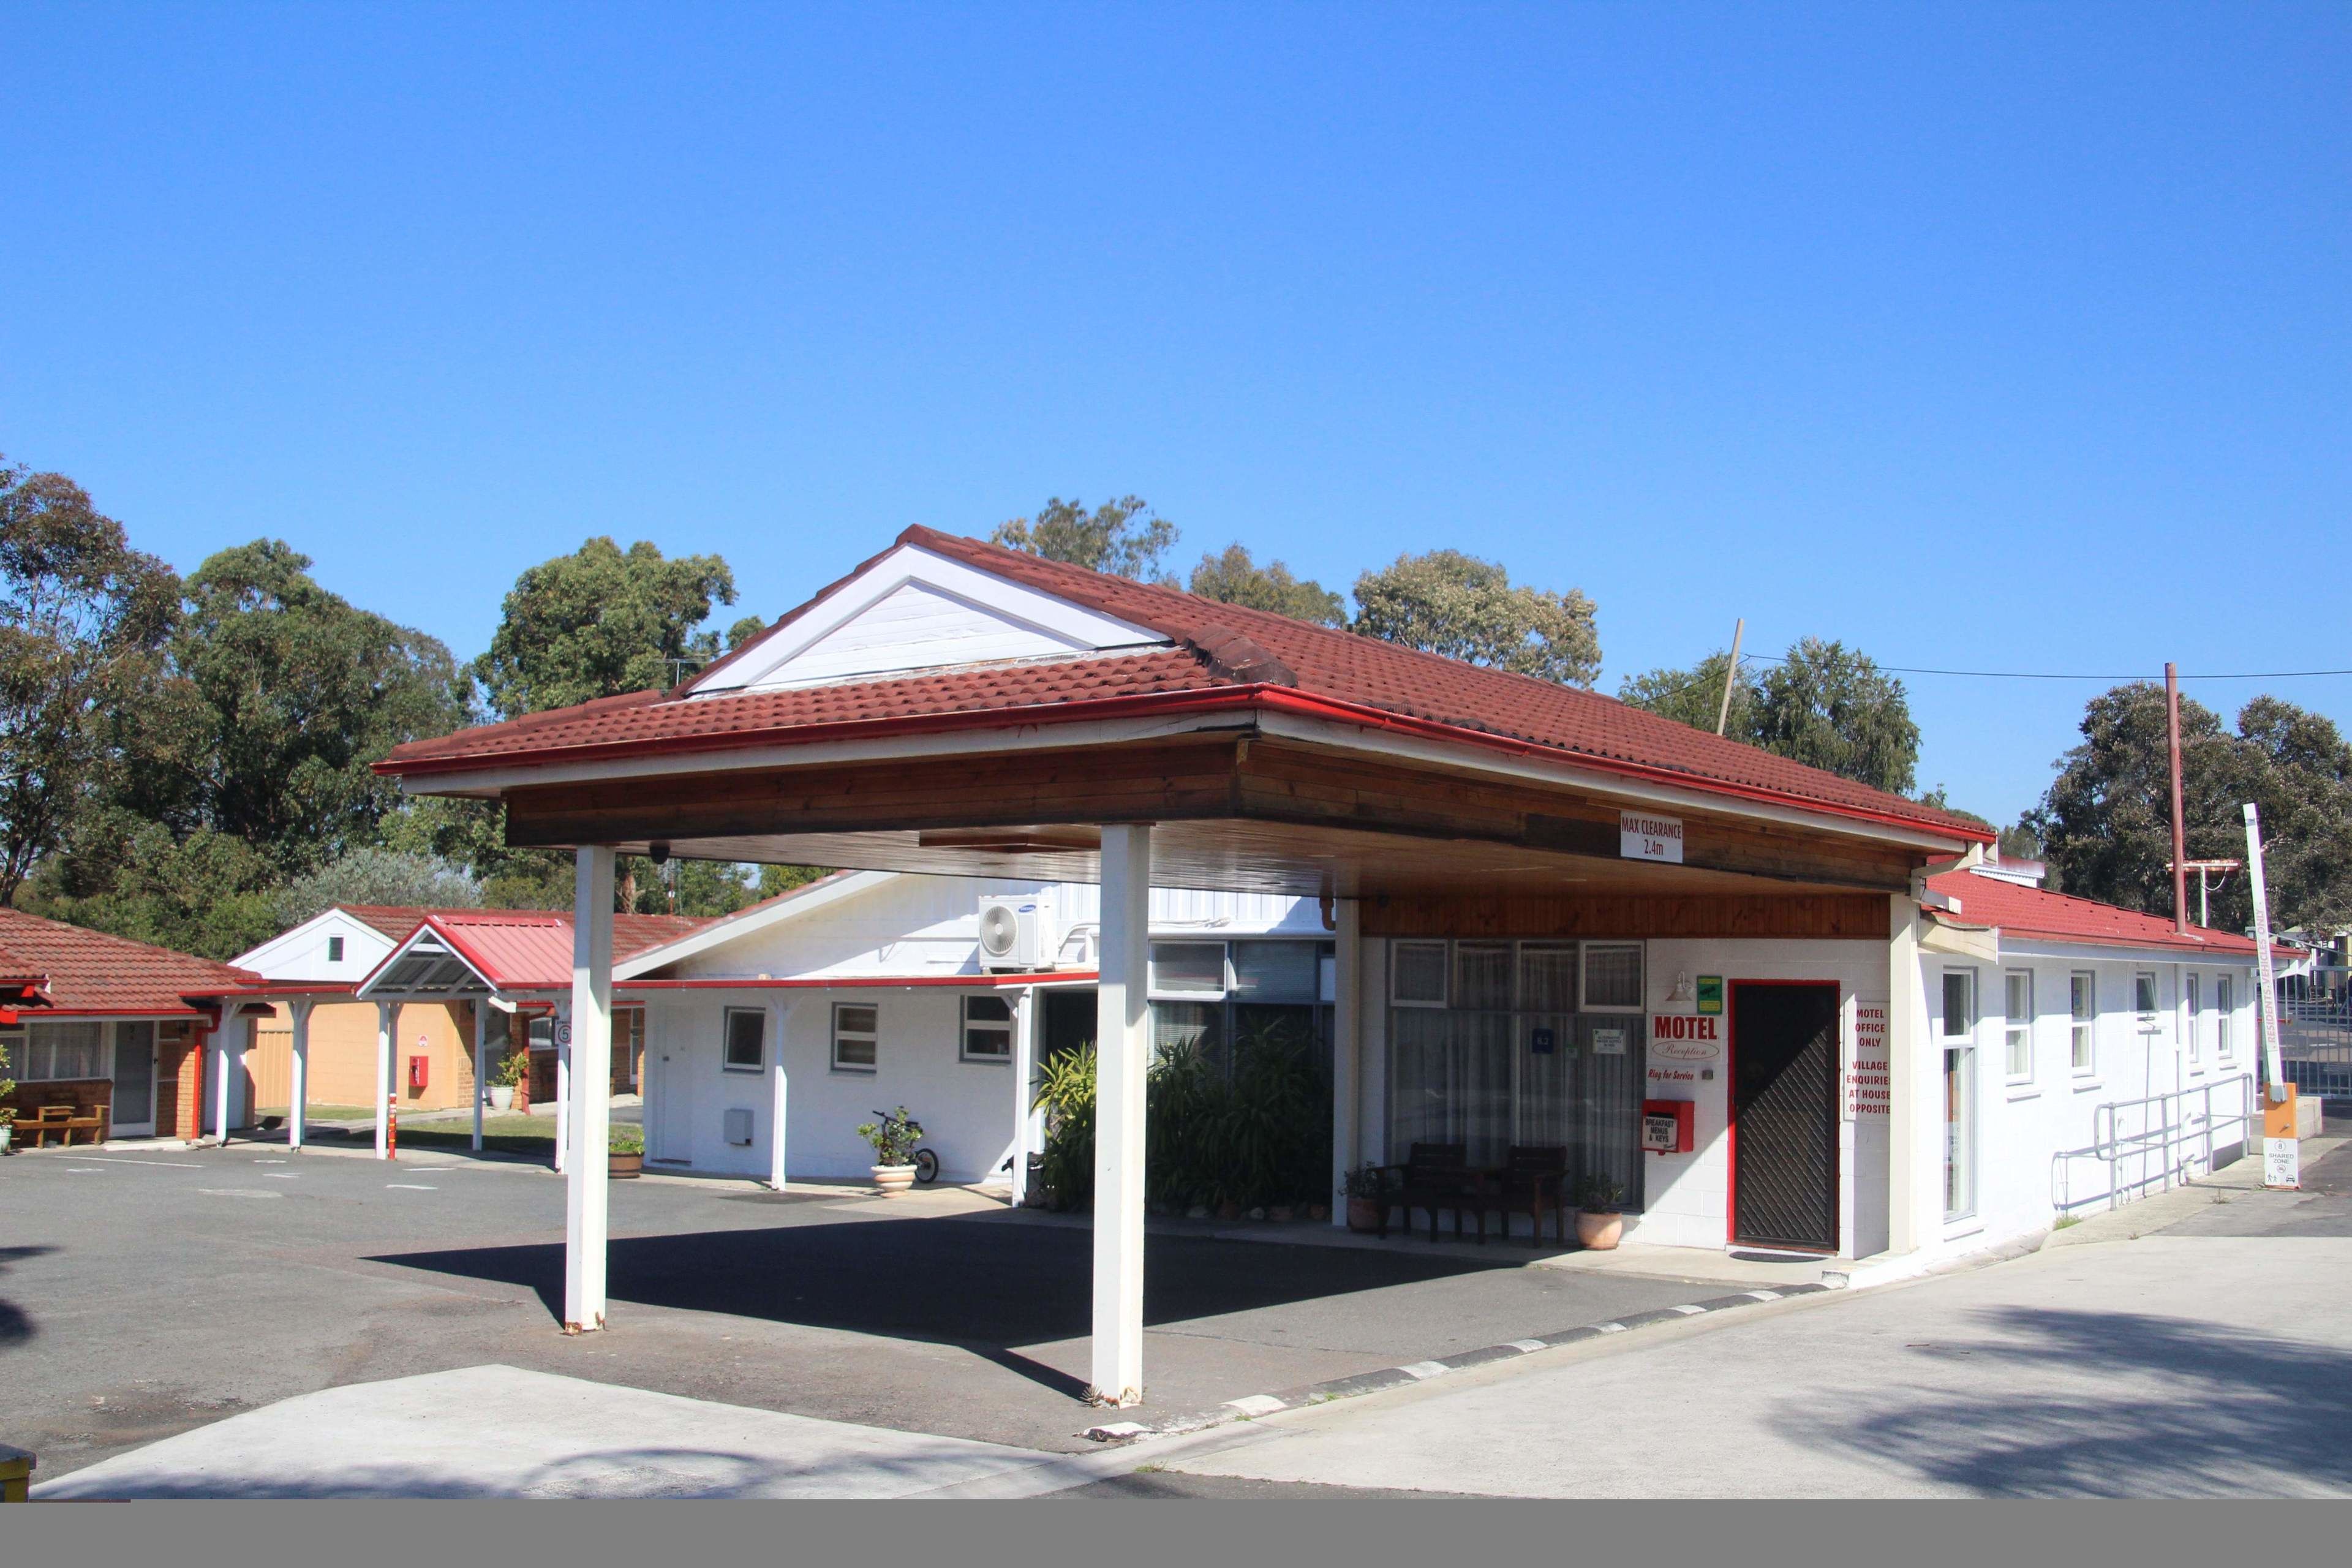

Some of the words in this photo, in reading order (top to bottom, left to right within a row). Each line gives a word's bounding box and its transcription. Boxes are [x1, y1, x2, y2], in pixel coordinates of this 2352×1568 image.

[1621, 817, 1639, 834] MAX
[1642, 820, 1681, 839] CLEARANCE
[1645, 839, 1664, 856] 2.4m
[2256, 909, 2264, 934] ONLY
[2259, 939, 2270, 984] VEHICLES
[1856, 1009, 1884, 1018] MOTEL
[2264, 989, 2275, 1042] RESIDENTS
[1654, 1016, 1717, 1039] MOTEL
[1855, 1023, 1885, 1033] OFFICE
[1859, 1038, 1881, 1047] ONLY
[1662, 1043, 1706, 1059] Reception
[1852, 1061, 1888, 1071] VILLAGE
[1648, 1069, 1662, 1081] Ring
[1663, 1069, 1672, 1079] for
[1673, 1070, 1694, 1080] Service
[1849, 1089, 1860, 1098] AT
[1863, 1090, 1890, 1100] HOUSE
[1850, 1104, 1890, 1114] OPPOSITE
[1645, 1118, 1674, 1128] BREAKFAST
